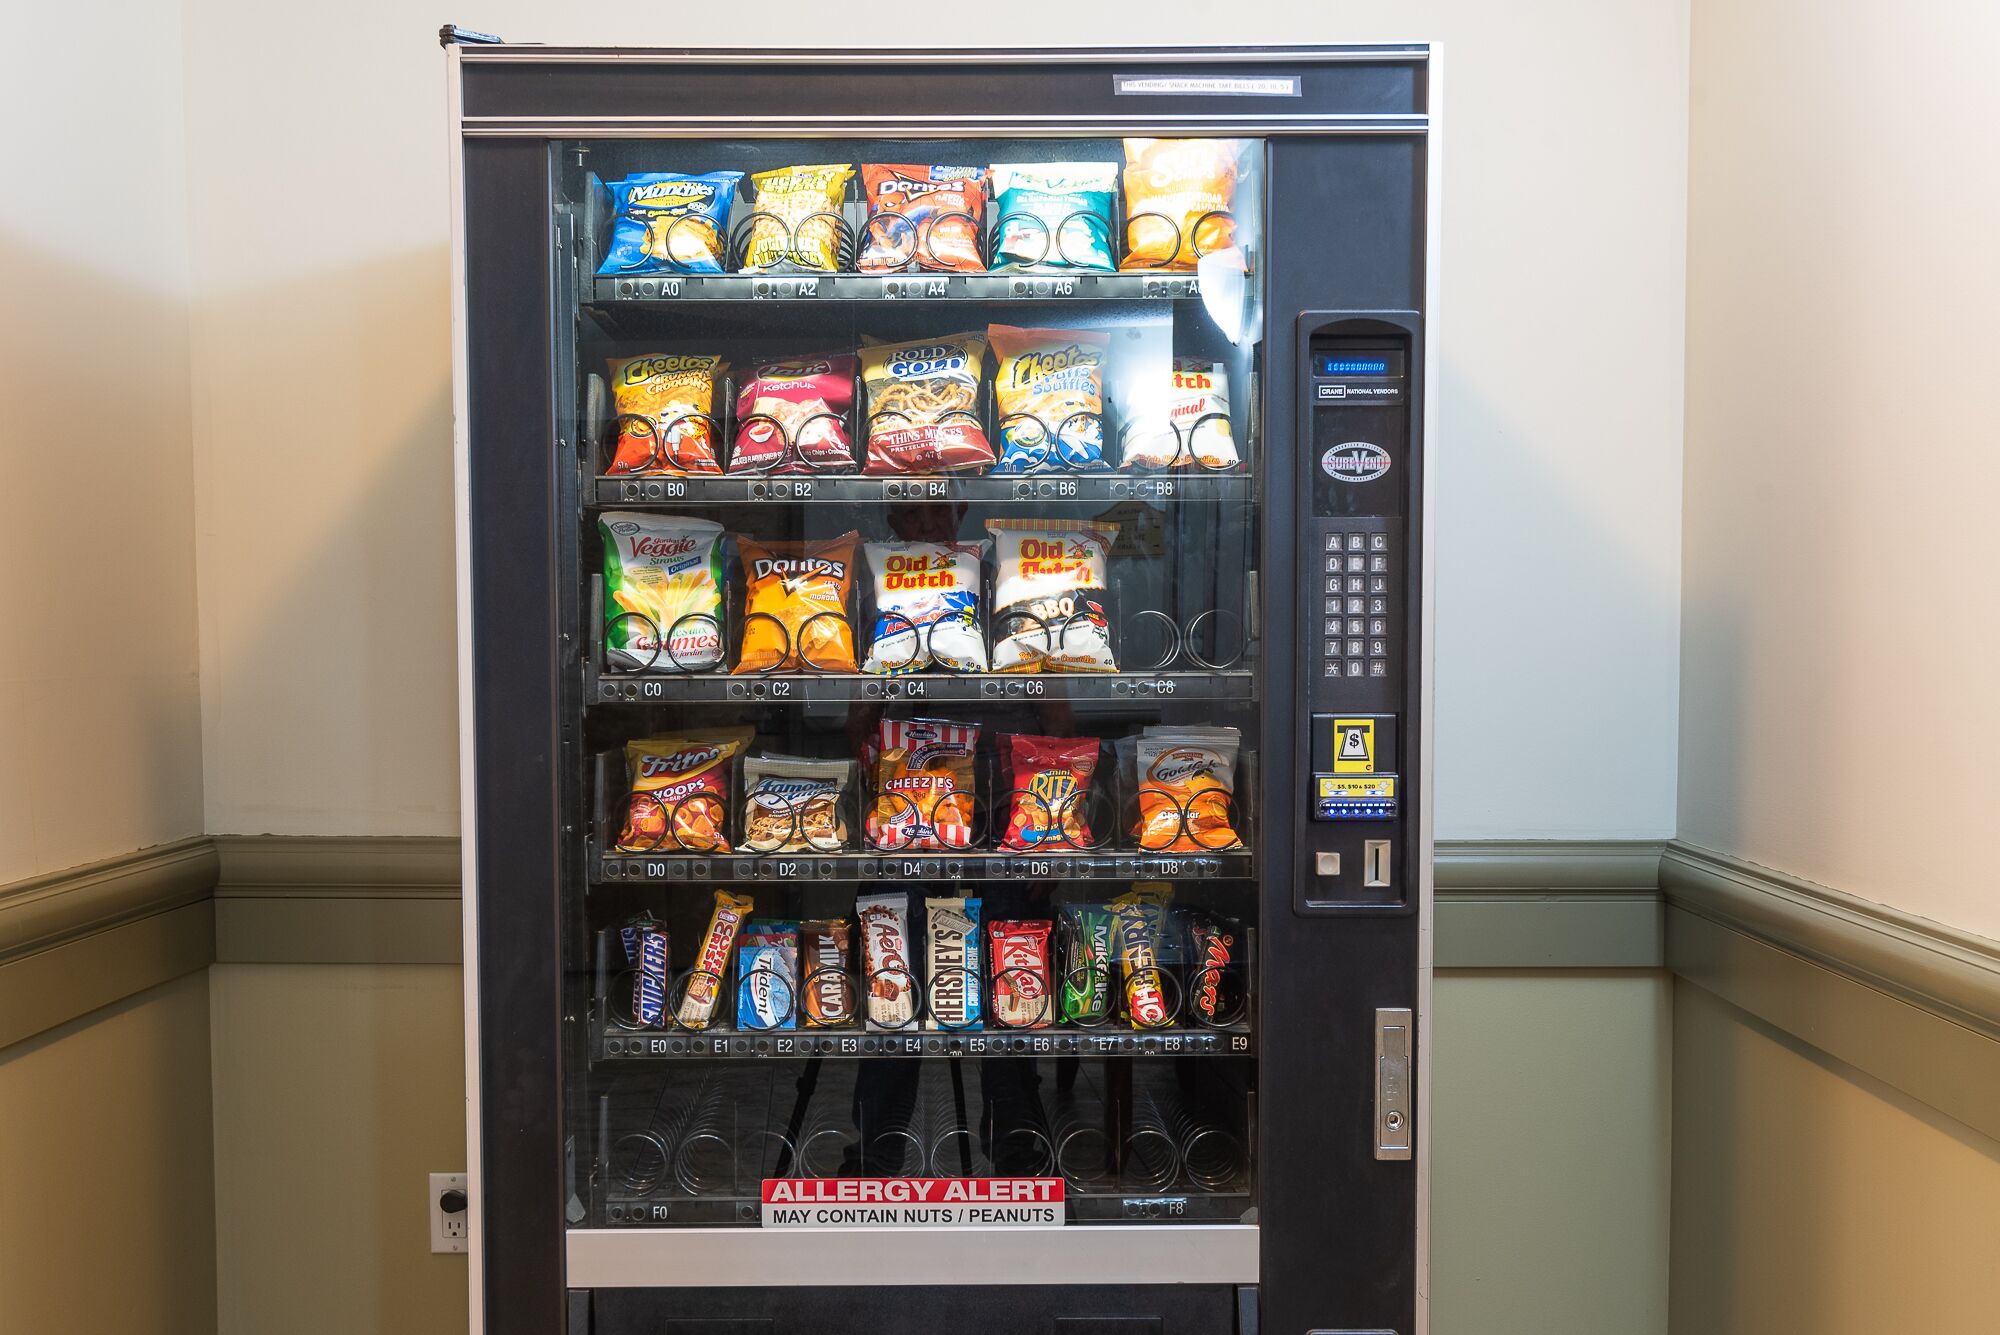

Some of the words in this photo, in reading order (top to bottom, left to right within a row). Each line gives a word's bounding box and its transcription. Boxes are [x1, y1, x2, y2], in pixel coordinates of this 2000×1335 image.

[628, 182, 714, 204] Munchies
[879, 181, 965, 195] Doritos
[661, 282, 679, 296] A0
[798, 282, 816, 296] A2
[928, 281, 946, 296] A4
[1054, 281, 1073, 295] A6
[1188, 280, 1200, 294] A
[891, 346, 946, 362] ROLD
[625, 355, 714, 385] Cheetos
[891, 357, 965, 377] GOLD
[646, 377, 710, 395] CROQUANT
[762, 380, 816, 393] Ketchup
[1174, 373, 1212, 389] tch
[1170, 398, 1207, 418] ginal
[889, 430, 920, 445] THINS
[667, 482, 684, 496] B0
[794, 483, 812, 496] B2
[930, 482, 946, 496] B4
[1060, 482, 1076, 496] B6
[1156, 482, 1173, 495] B8
[630, 536, 696, 558] Veggie
[1329, 536, 1338, 548] A
[1352, 536, 1360, 548] B
[1374, 536, 1382, 548] C
[1020, 539, 1063, 560] Old
[755, 558, 844, 580] Doritos
[886, 555, 928, 572] Old
[1329, 558, 1338, 569] D
[1352, 558, 1360, 569] E
[1374, 558, 1382, 569] F
[886, 570, 954, 589] Dutch
[1329, 578, 1338, 590] G
[1352, 578, 1360, 590] H
[1374, 578, 1382, 590] J
[1030, 597, 1074, 620] BBQ
[1329, 600, 1338, 612] 1
[1352, 600, 1360, 612] 2
[1374, 600, 1382, 612] 3
[1329, 620, 1338, 632] 4
[1352, 620, 1360, 632] 5
[1374, 620, 1382, 632] 6
[1329, 642, 1338, 654] 7
[1352, 642, 1360, 654] 8
[1374, 642, 1382, 654] 9
[1352, 662, 1360, 674] 0
[644, 682, 662, 696] C0
[772, 682, 790, 696] C2
[907, 682, 924, 696] C4
[1026, 680, 1044, 694] C6
[1156, 680, 1174, 694] C8
[642, 748, 720, 777] Fritos
[652, 780, 704, 798] HOOPS
[1032, 773, 1078, 805] RITZ
[905, 827, 932, 836] Hakins
[648, 864, 665, 876] D0
[780, 862, 797, 876] D2
[904, 862, 920, 876] D4
[1031, 862, 1048, 875] D6
[1161, 862, 1178, 874] D8
[703, 921, 725, 970] CRISP
[707, 924, 734, 987] COFFEE
[643, 932, 666, 1026] SNICKERS
[935, 930, 964, 1022] HERSHEY'S
[1200, 936, 1230, 1017] Mars
[758, 958, 772, 1015] Trident
[968, 976, 978, 1006] COOKIES
[1136, 987, 1164, 1023] OH
[652, 1039, 666, 1053] E0
[714, 1040, 728, 1052] E1
[778, 1040, 793, 1052] E2
[842, 1039, 857, 1052] E3
[906, 1038, 921, 1052] E4
[970, 1038, 985, 1052] E5
[1034, 1038, 1050, 1050] E6
[1100, 1038, 1114, 1050] E7
[1165, 1037, 1180, 1050] E8
[1232, 1036, 1248, 1050] E9
[770, 1180, 934, 1201] ALLERGY
[942, 1180, 1056, 1201] ALERT
[652, 1206, 668, 1220] F0
[1169, 1202, 1184, 1214] F8
[773, 1209, 811, 1224] MAY
[816, 1209, 898, 1224] CONTAIN
[904, 1208, 952, 1223] NUTS
[958, 1208, 964, 1223] /
[968, 1208, 1054, 1222] PEANUTS
